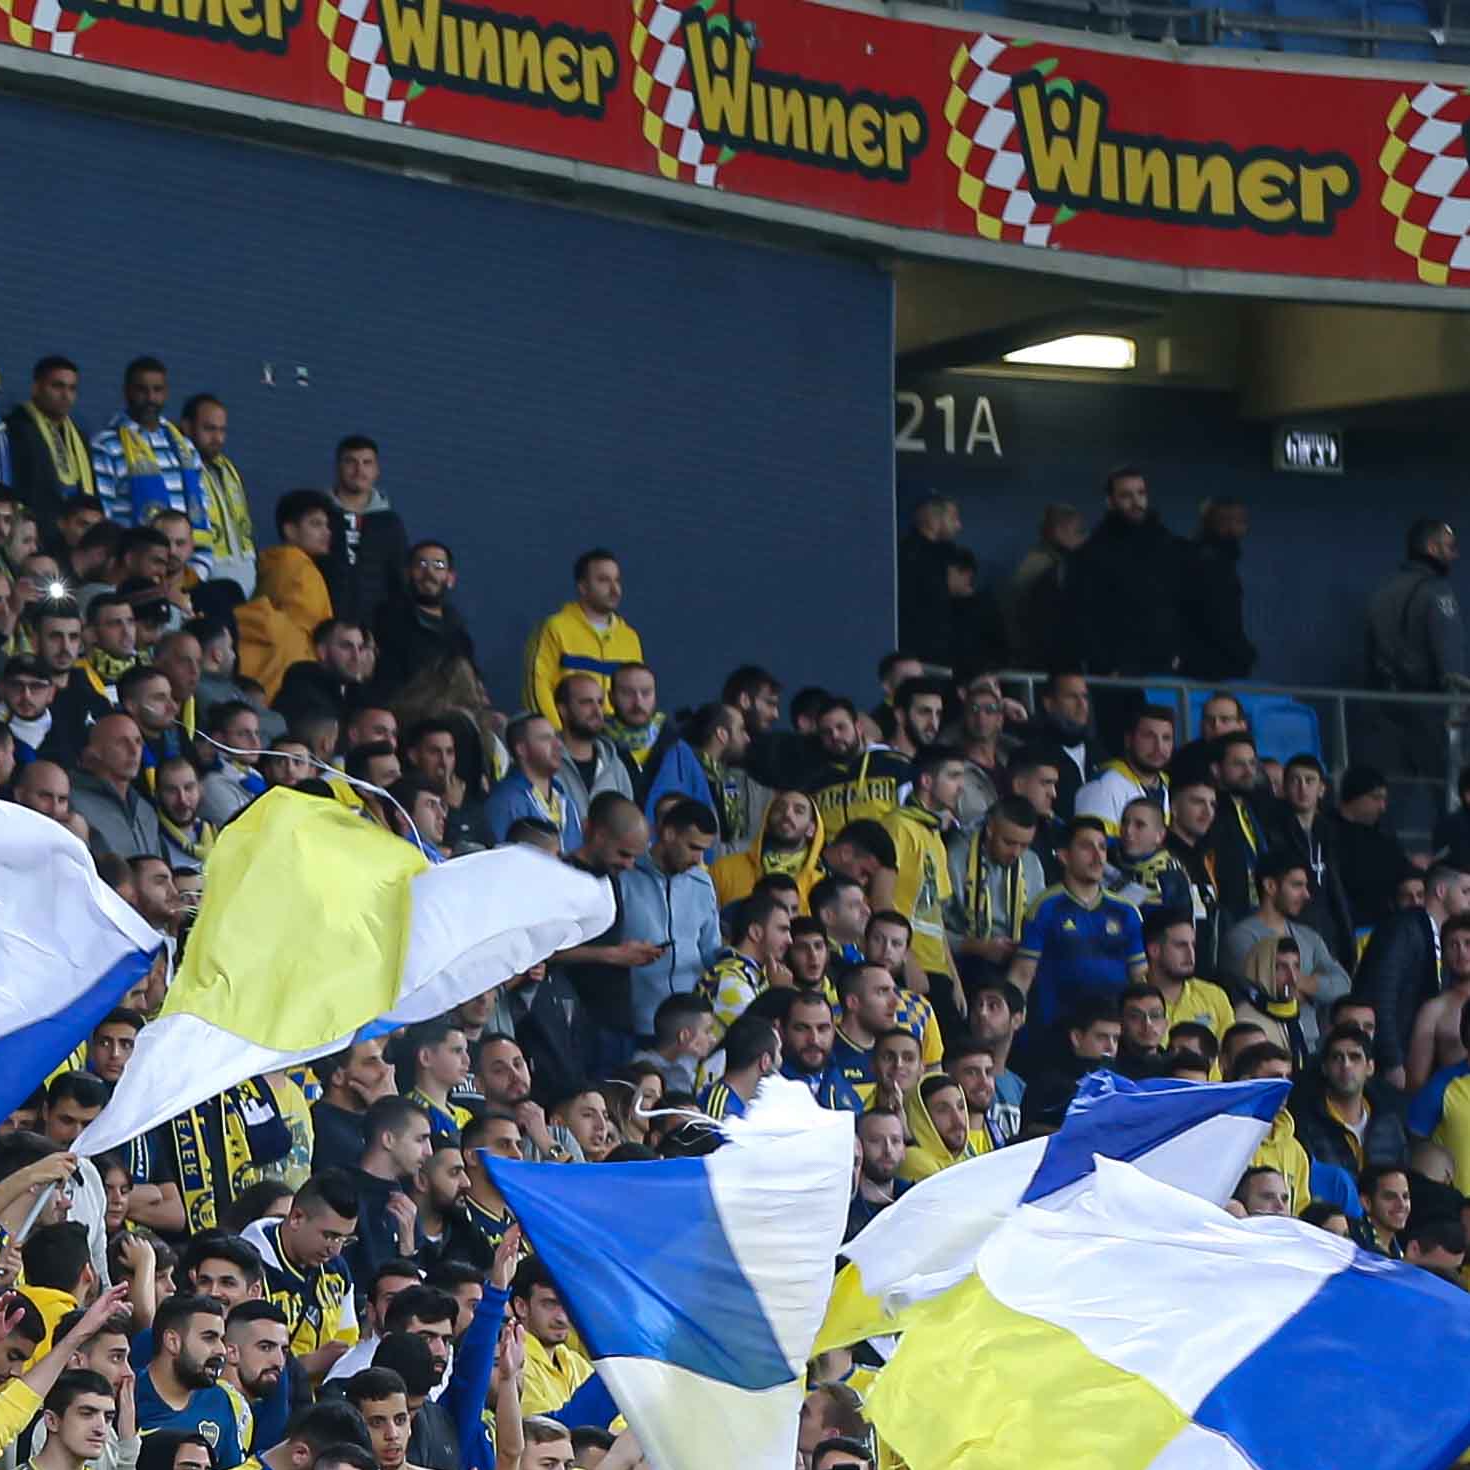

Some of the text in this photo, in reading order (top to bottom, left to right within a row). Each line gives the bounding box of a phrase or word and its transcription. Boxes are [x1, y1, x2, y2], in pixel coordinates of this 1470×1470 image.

[380, 0, 613, 106] Winner
[684, 25, 922, 173] Winner
[1017, 84, 1351, 224] Winner
[895, 392, 1003, 457] 21A
